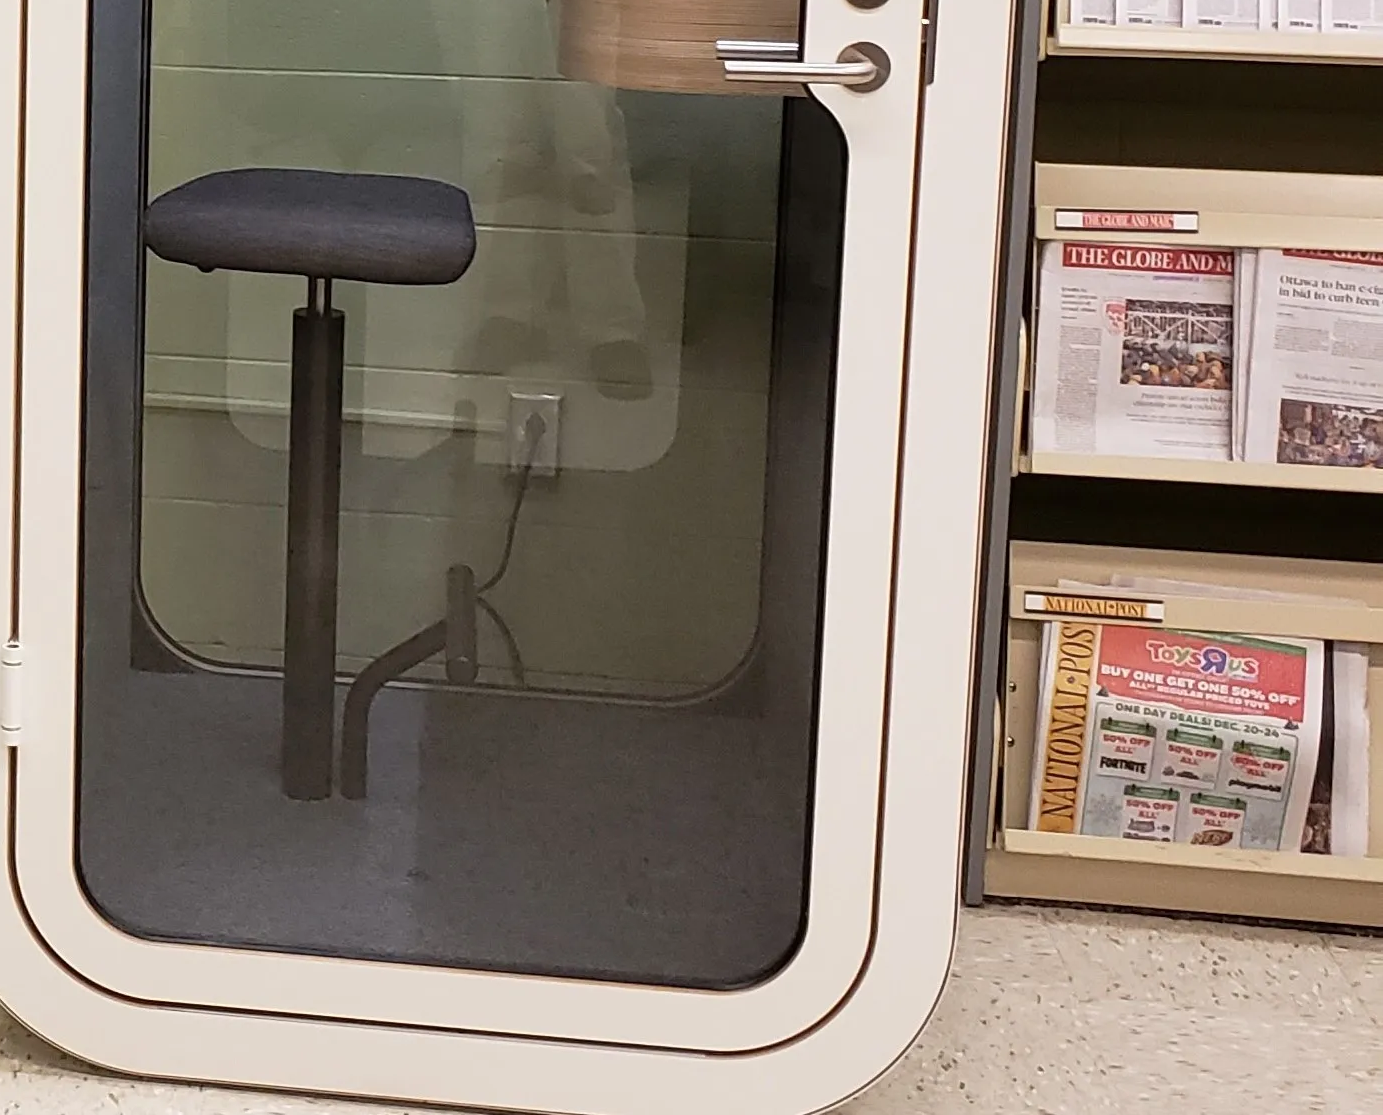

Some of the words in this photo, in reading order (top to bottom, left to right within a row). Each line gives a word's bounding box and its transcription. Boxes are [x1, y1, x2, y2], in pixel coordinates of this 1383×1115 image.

[1068, 246, 1109, 265] THE
[1112, 249, 1173, 269] GLOBE
[1176, 253, 1214, 271] AND
[1280, 275, 1318, 287] Ottawa
[1321, 280, 1333, 288] to
[1336, 280, 1356, 292] ban
[1279, 287, 1289, 296] in
[1293, 288, 1310, 298] bid
[1314, 291, 1325, 300] to
[1328, 293, 1353, 303] curb
[1356, 296, 1380, 307] teen
[1045, 596, 1107, 615] NATIONAL
[1116, 602, 1147, 617] POST
[1059, 622, 1096, 676] POS
[1101, 664, 1131, 678] BUY
[1133, 670, 1165, 684] ONE
[1166, 676, 1195, 689] GET
[1197, 681, 1229, 695] ONE
[1231, 686, 1266, 701] 50%
[1157, 685, 1203, 698] REGULAR
[1205, 693, 1243, 704] PRICED
[1244, 699, 1270, 710] TOYS
[1116, 702, 1140, 714] ONE
[1143, 707, 1166, 718] DAY
[1170, 712, 1211, 725] DEALS!
[1244, 725, 1279, 738] 20-24
[1103, 734, 1127, 744] 50%
[1130, 737, 1150, 747] OFF
[1041, 684, 1089, 820] NATIONAL
[1168, 745, 1193, 756] 50%
[1195, 750, 1217, 759] OFF
[1100, 756, 1147, 774] FORTNITE
[1263, 762, 1284, 771] OFF
